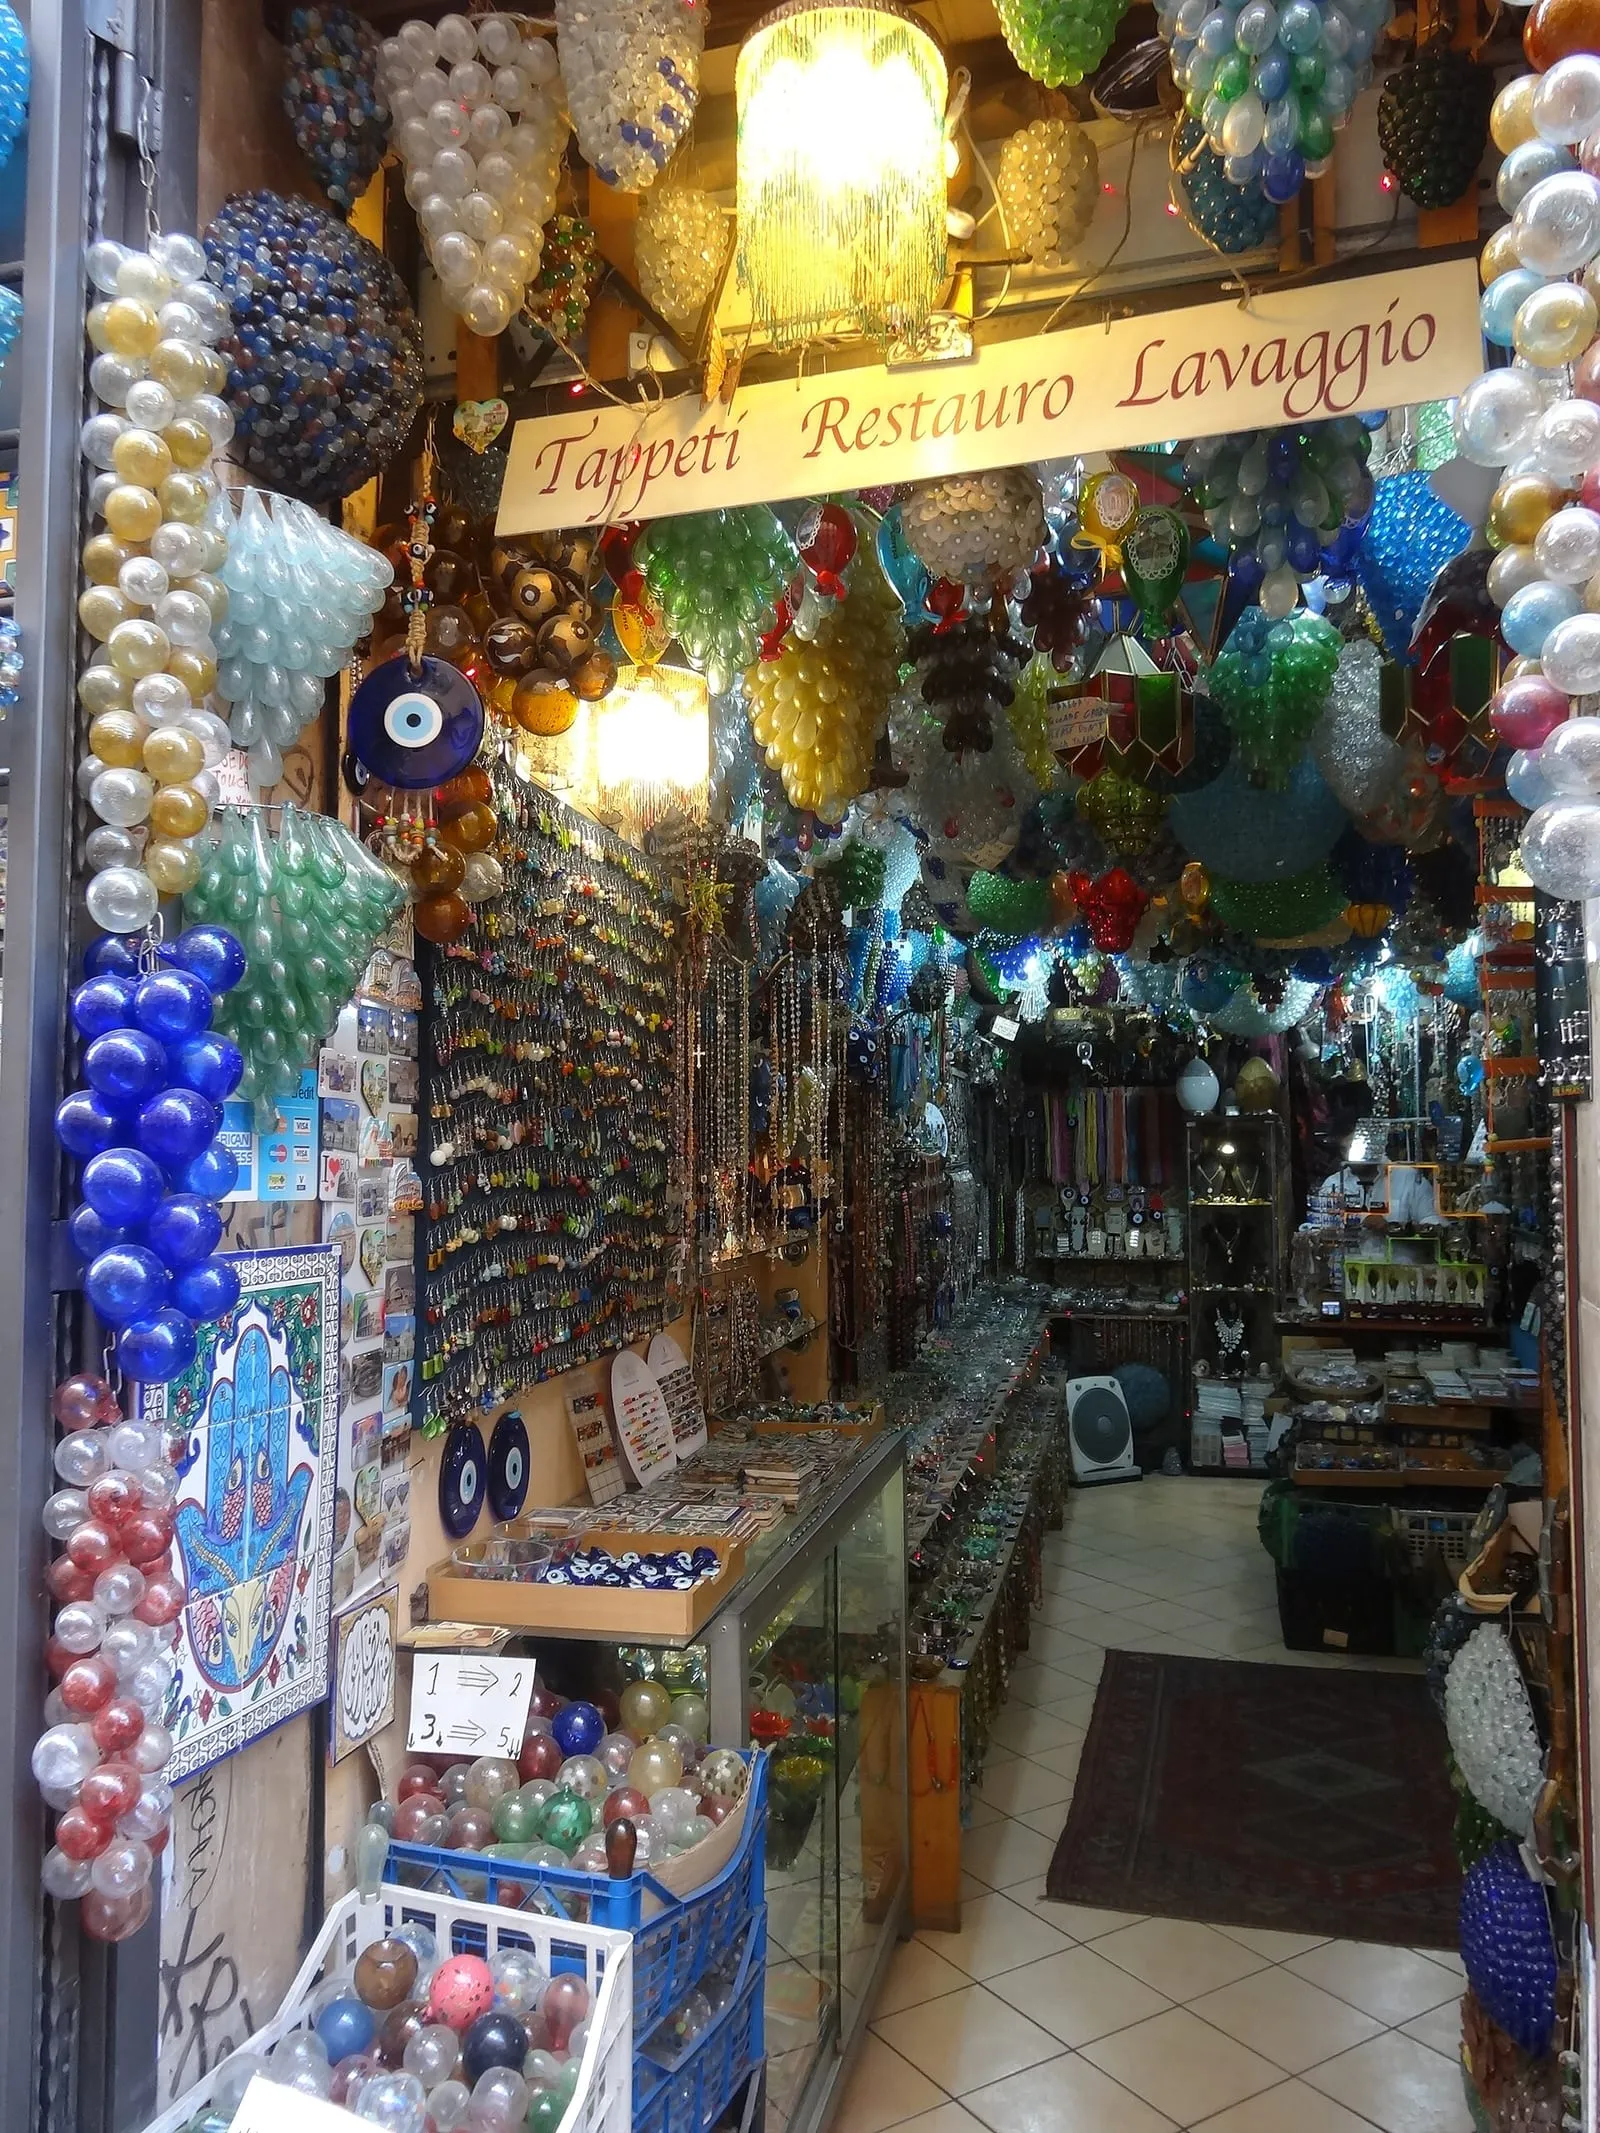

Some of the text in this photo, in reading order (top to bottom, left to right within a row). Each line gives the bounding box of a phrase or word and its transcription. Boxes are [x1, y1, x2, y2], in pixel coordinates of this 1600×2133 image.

[534, 298, 1437, 521] Tappeti Restauro Lavaggio
[296, 1122, 309, 1130] VISA
[295, 1150, 308, 1158] VISA
[426, 1662, 522, 1697] 1 2
[420, 1713, 511, 1748] 3 5
